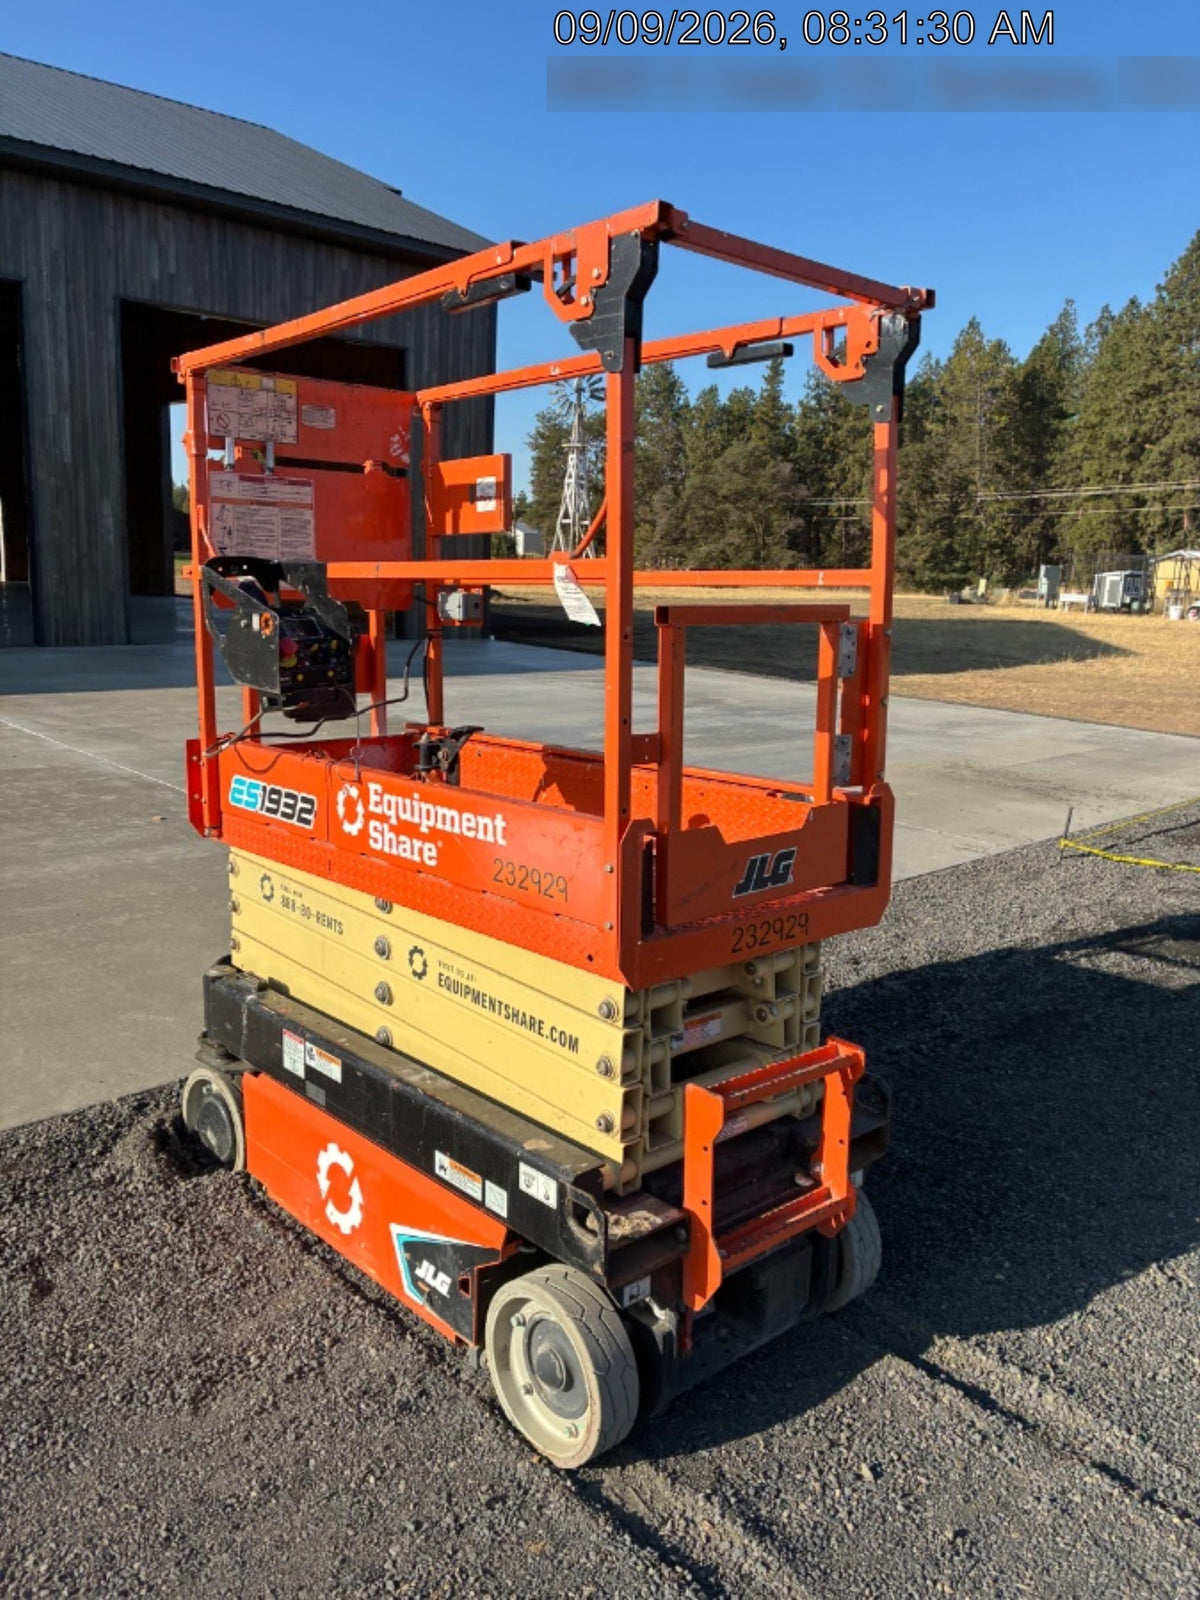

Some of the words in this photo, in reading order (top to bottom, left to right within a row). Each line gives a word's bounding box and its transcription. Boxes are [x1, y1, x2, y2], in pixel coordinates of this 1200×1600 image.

[229, 775, 317, 830] ES1932
[367, 782, 507, 846] Equipment
[493, 858, 569, 903] 232929
[733, 847, 797, 898] JLG
[731, 912, 809, 953] 232929
[438, 973, 580, 1054] EQUIPMENTSHARE.COM
[414, 1259, 452, 1298] JLG
